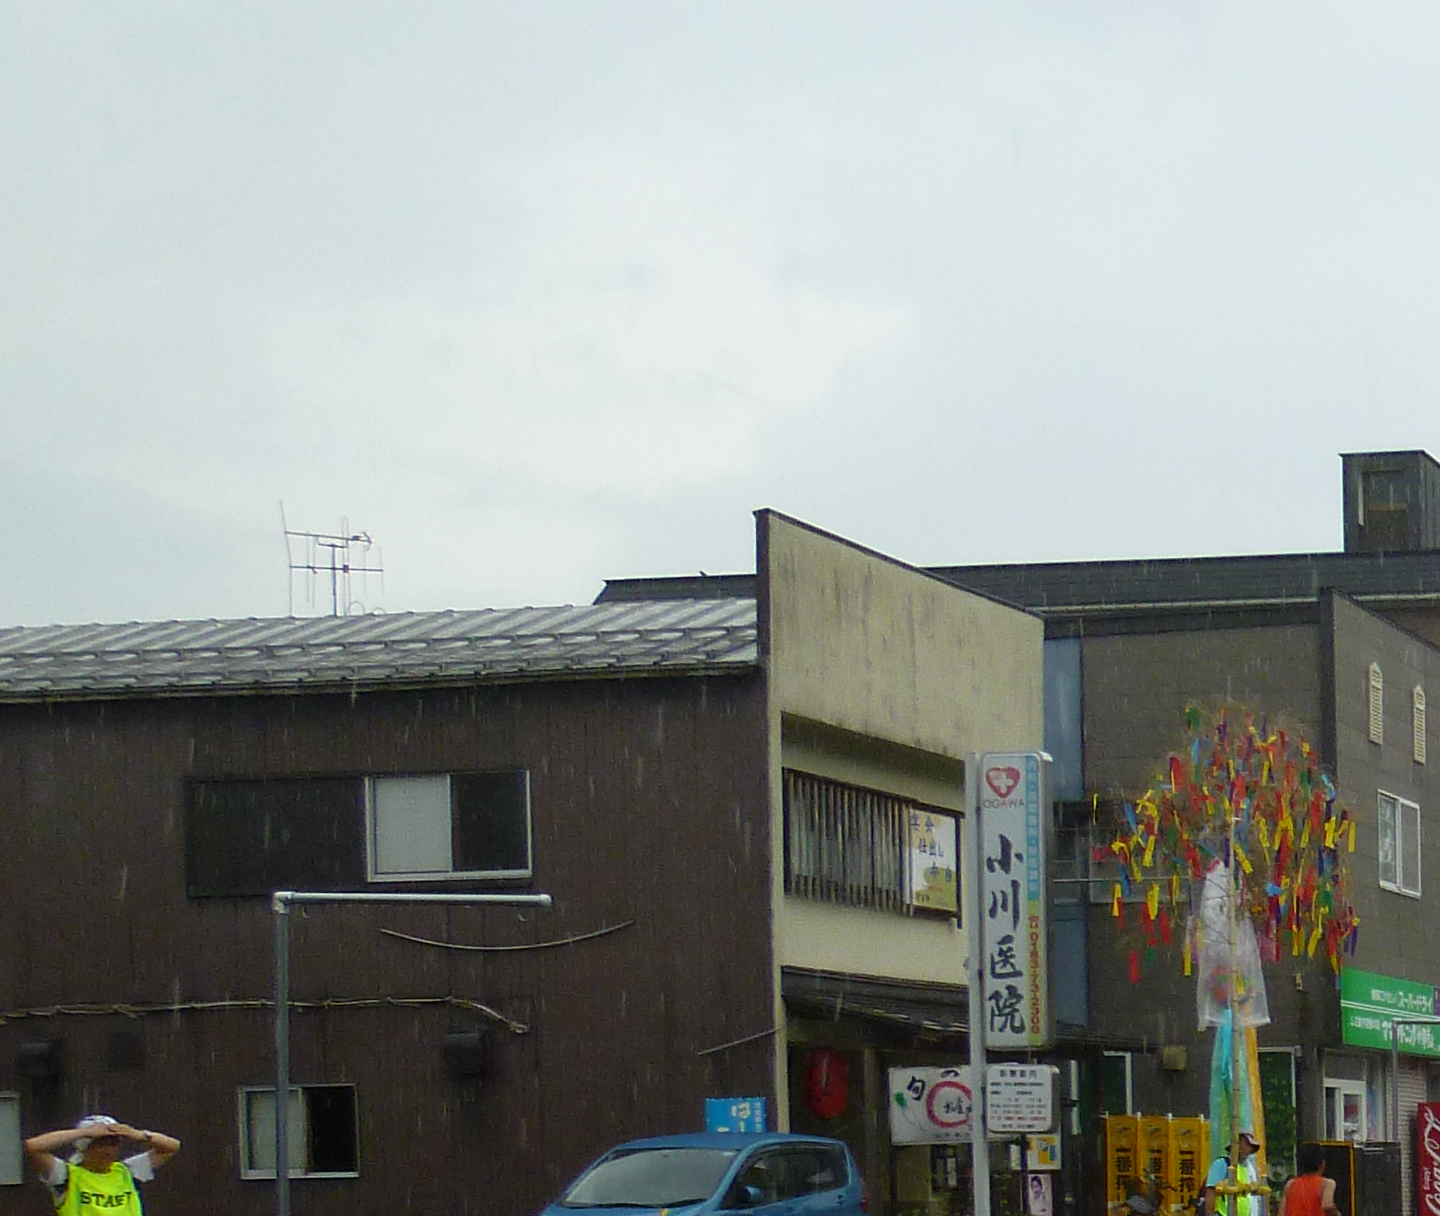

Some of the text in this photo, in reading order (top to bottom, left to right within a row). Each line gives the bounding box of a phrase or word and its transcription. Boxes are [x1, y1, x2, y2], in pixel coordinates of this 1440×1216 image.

[982, 798, 1025, 809] OGAWA
[985, 833, 1027, 1034] 小川医院
